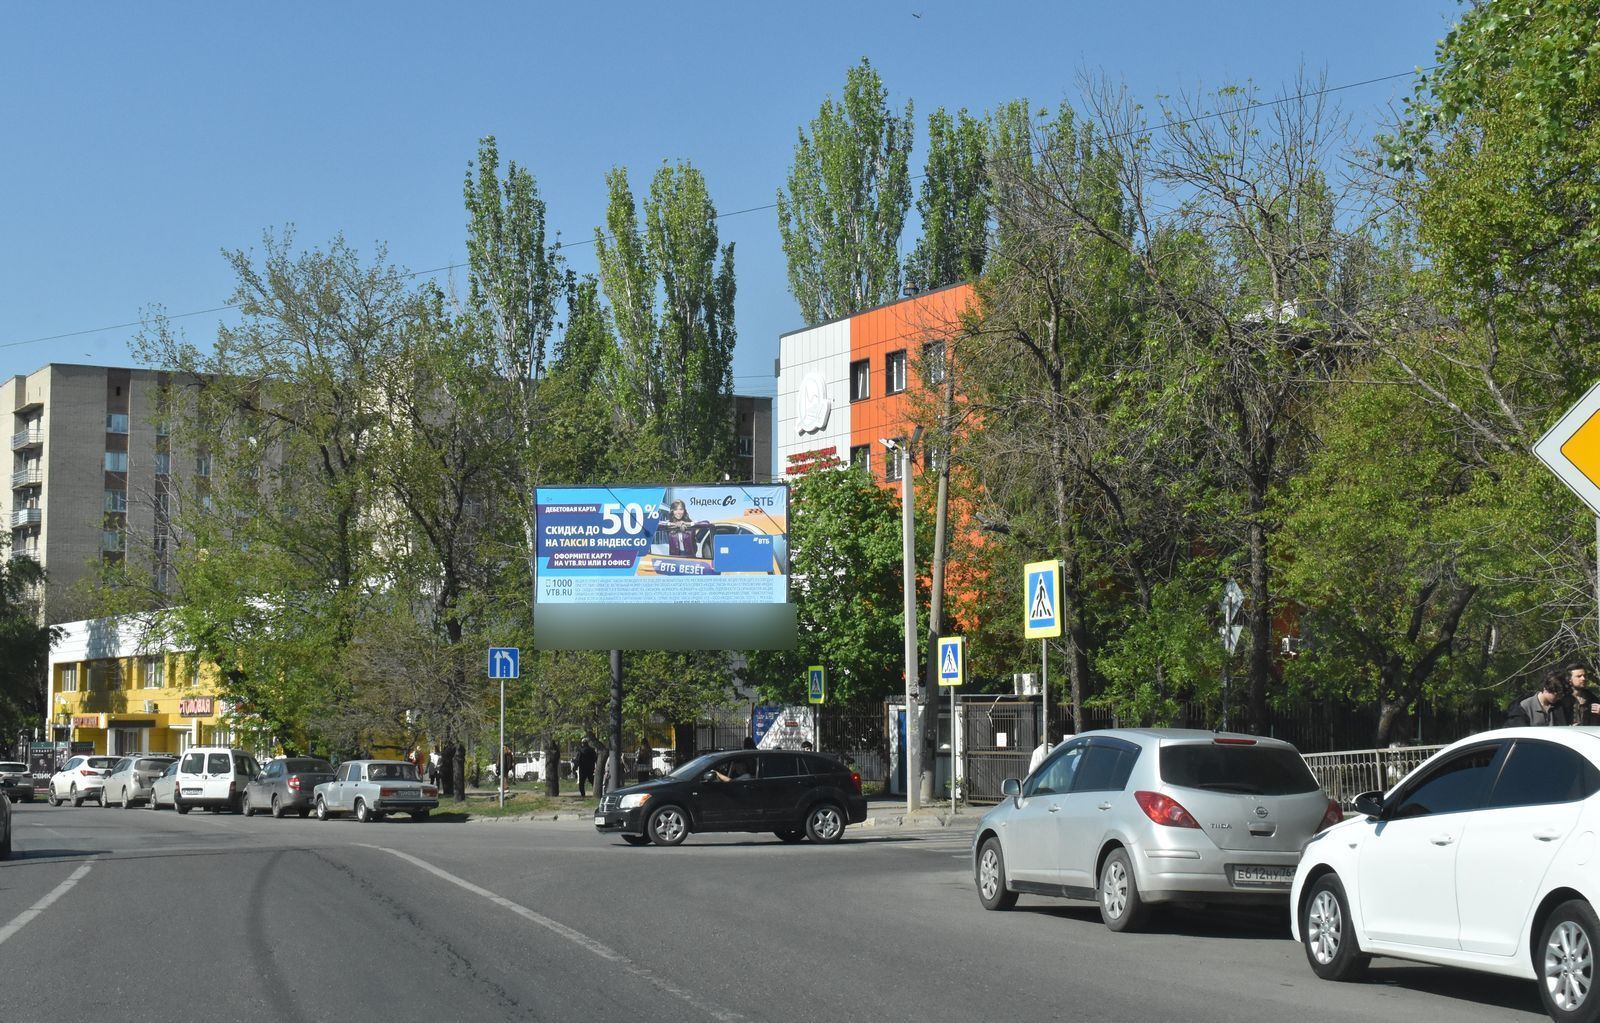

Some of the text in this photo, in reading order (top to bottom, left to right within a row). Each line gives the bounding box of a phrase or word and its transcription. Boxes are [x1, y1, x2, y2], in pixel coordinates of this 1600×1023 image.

[690, 495, 737, 507] Яндекс Go
[753, 497, 774, 506] ВТБ
[545, 503, 660, 536] СКИДКА ДО 50%
[545, 538, 647, 548] НА ТАКСИ В ЯНДЕКС GO
[660, 562, 705, 575] ВТБ ВЕЗЁТ
[553, 579, 573, 587] 1000
[546, 588, 573, 596] VTB.RU
